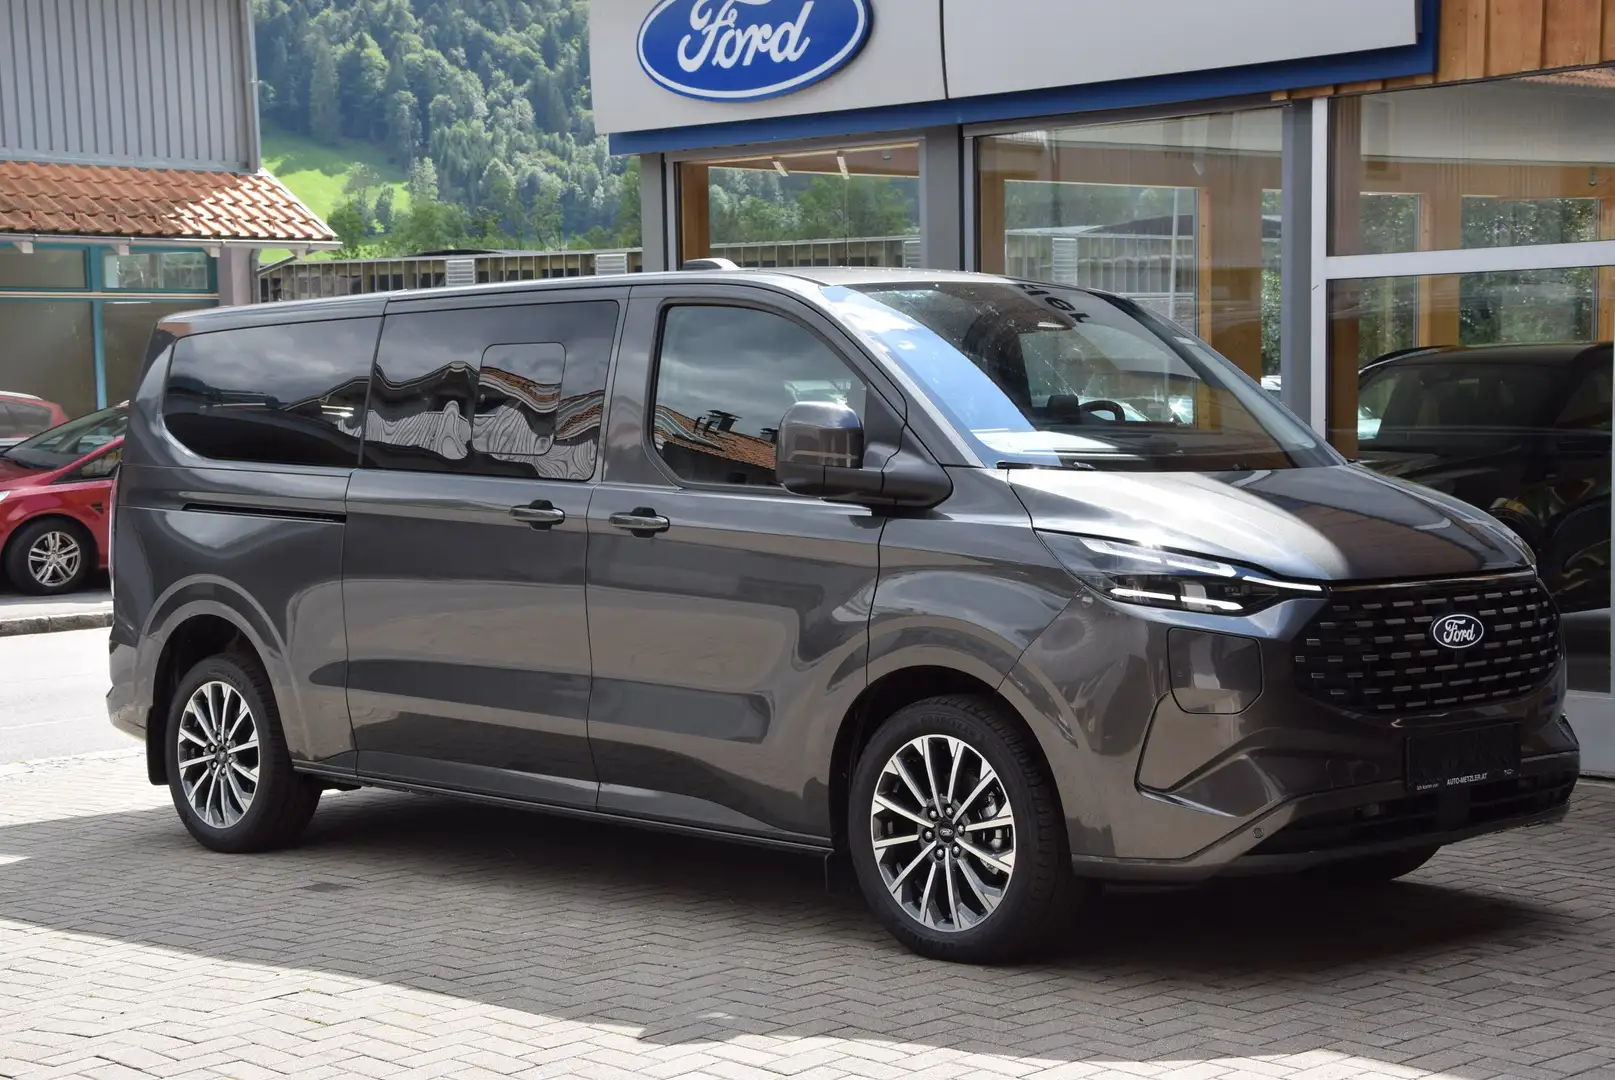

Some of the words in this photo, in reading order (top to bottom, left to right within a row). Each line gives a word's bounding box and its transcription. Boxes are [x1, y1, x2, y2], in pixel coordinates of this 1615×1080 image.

[677, 0, 814, 73] Ford
[1443, 619, 1476, 643] Ford
[1447, 773, 1487, 785] AUTO-METZLER.AT
